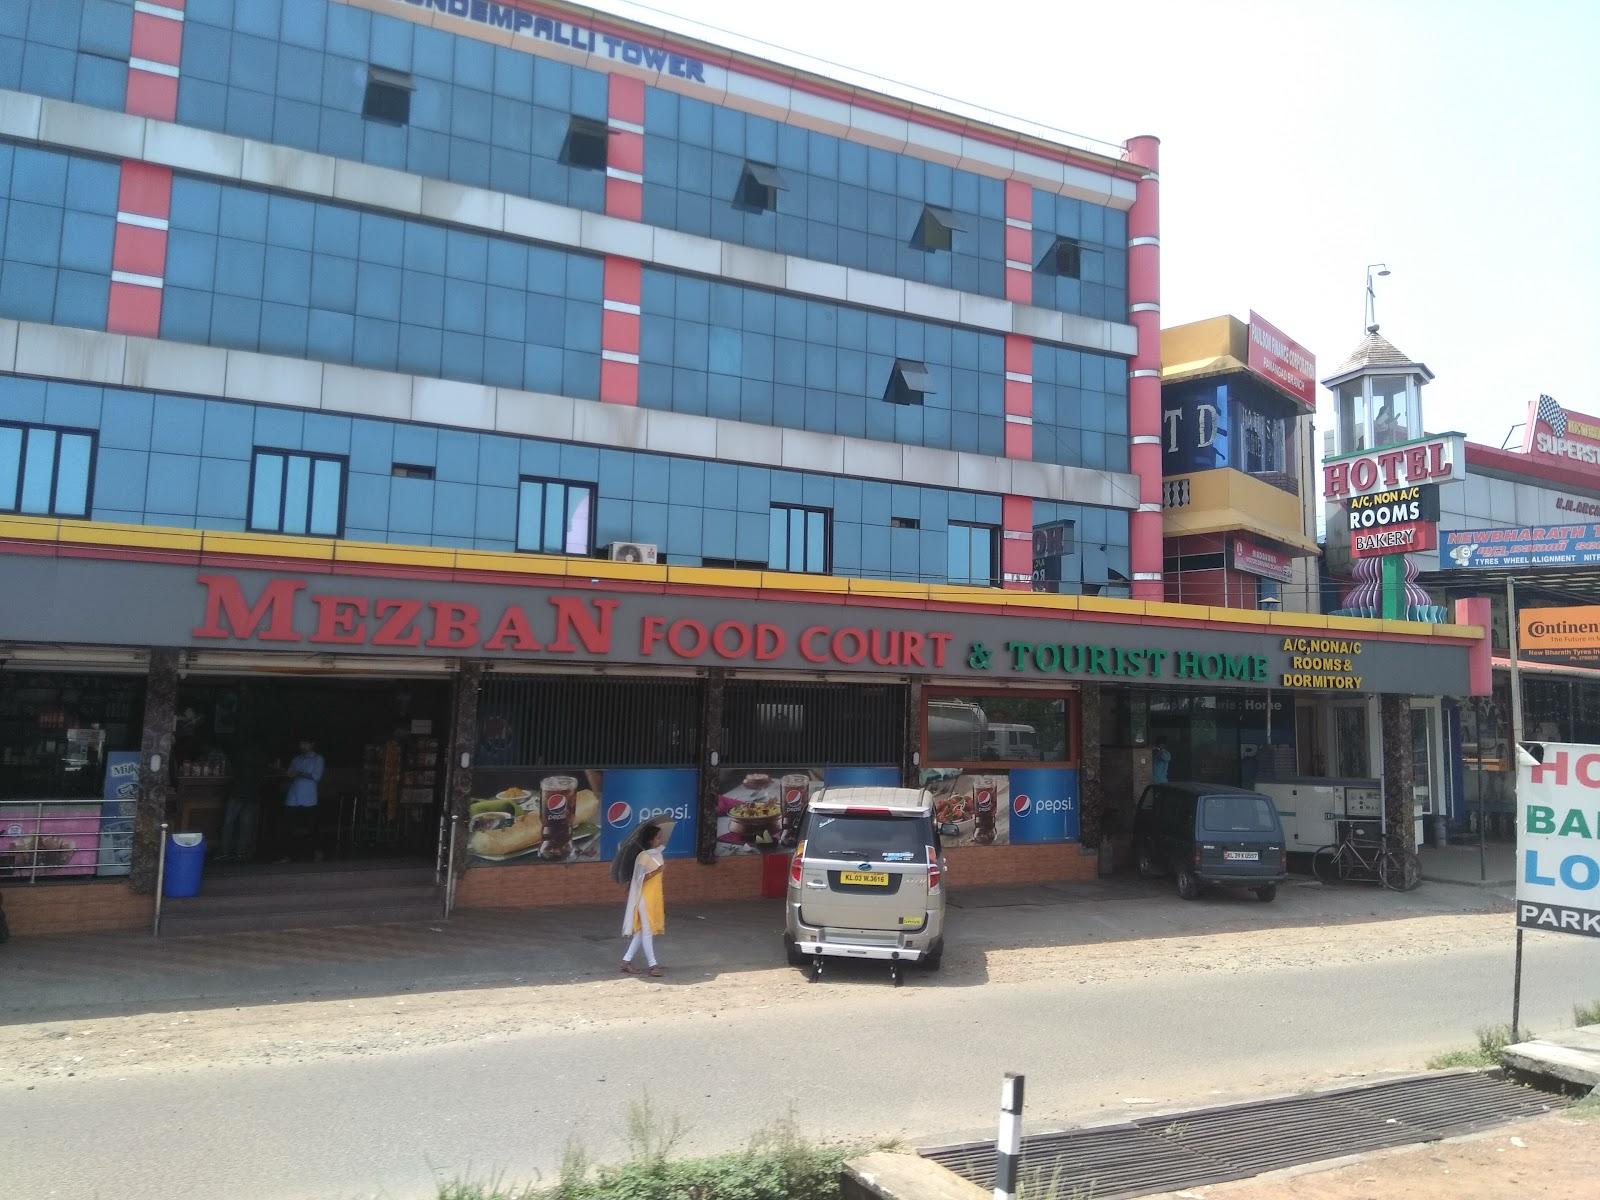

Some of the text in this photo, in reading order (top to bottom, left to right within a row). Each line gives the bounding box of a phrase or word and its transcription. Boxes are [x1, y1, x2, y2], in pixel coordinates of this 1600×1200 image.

[602, 35, 706, 83] TOWER
[1323, 443, 1452, 498] HOTEL
[1374, 492, 1398, 505] NON
[1400, 487, 1420, 500] A/C
[1350, 502, 1420, 529] ROOMS
[1356, 528, 1416, 551] BAKERY
[1447, 526, 1586, 544] NEWBHARATH
[1475, 557, 1499, 566] TYRES
[1503, 556, 1529, 564] WHEEL
[1531, 554, 1576, 563] ALIGNMENT
[192, 574, 1270, 682] MEZBAN FOOD COURT & TOURIST HOME
[1528, 620, 1600, 638] Continen
[1293, 656, 1353, 672] ROOMS &
[1283, 673, 1363, 689] DORMITORY
[1035, 797, 1072, 814] pepsi
[1526, 804, 1600, 839] BA
